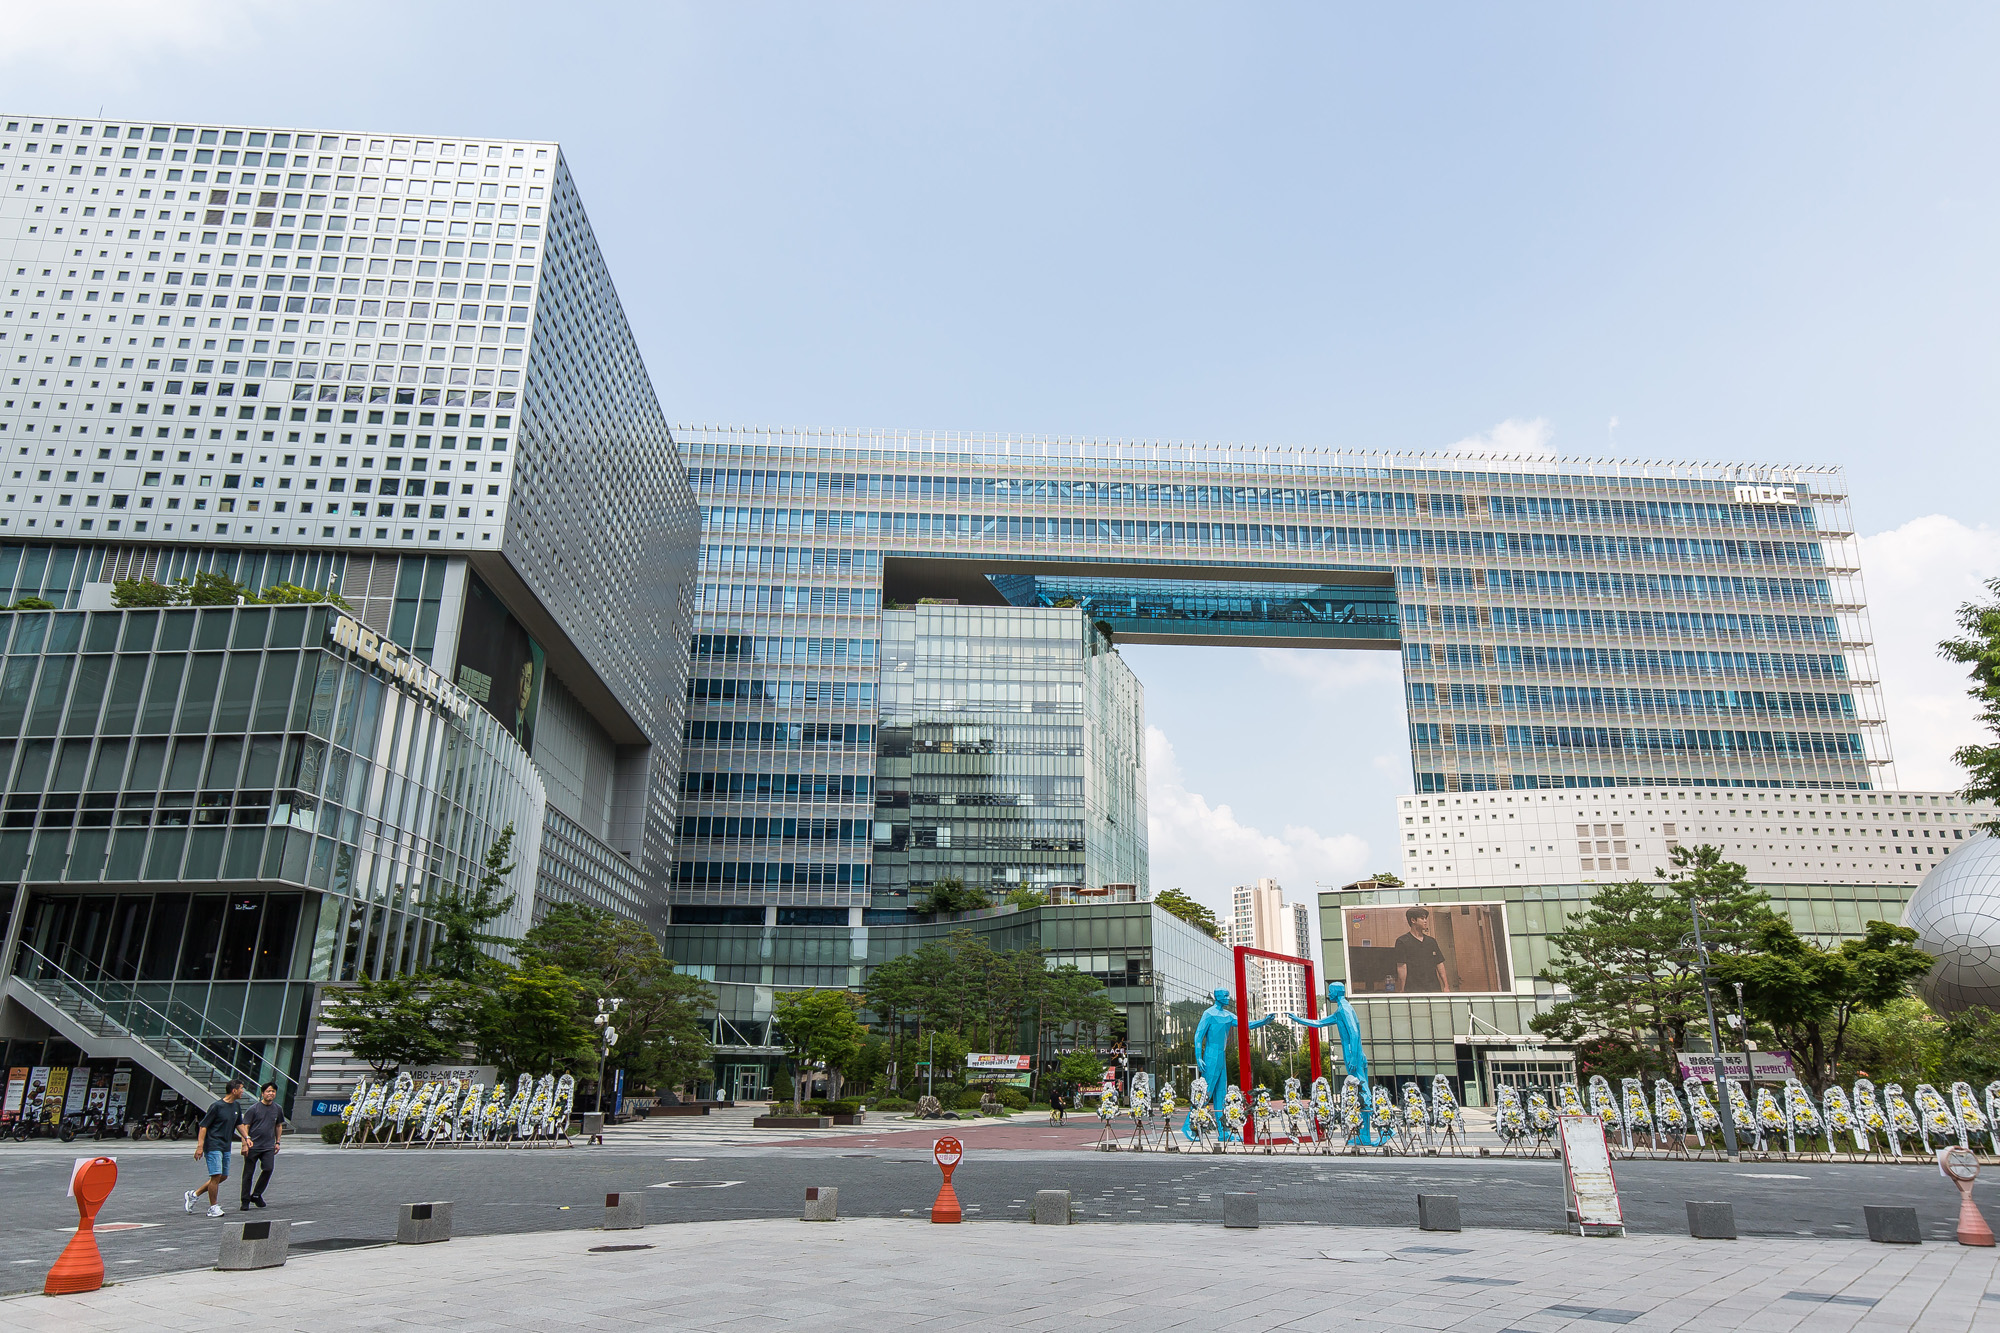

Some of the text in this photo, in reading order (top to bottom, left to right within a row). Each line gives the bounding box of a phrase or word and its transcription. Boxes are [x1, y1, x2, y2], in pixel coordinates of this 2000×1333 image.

[1734, 486, 1797, 505] MBC
[333, 615, 398, 674] MBC
[395, 658, 439, 700] MALL
[438, 680, 470, 722] PARK
[1725, 1056, 1742, 1065] 폭주
[410, 1071, 429, 1080] MBC
[429, 1070, 451, 1081] 뉴스에
[467, 1069, 479, 1079] 것?
[1754, 1065, 1789, 1074] 규탄한다!
